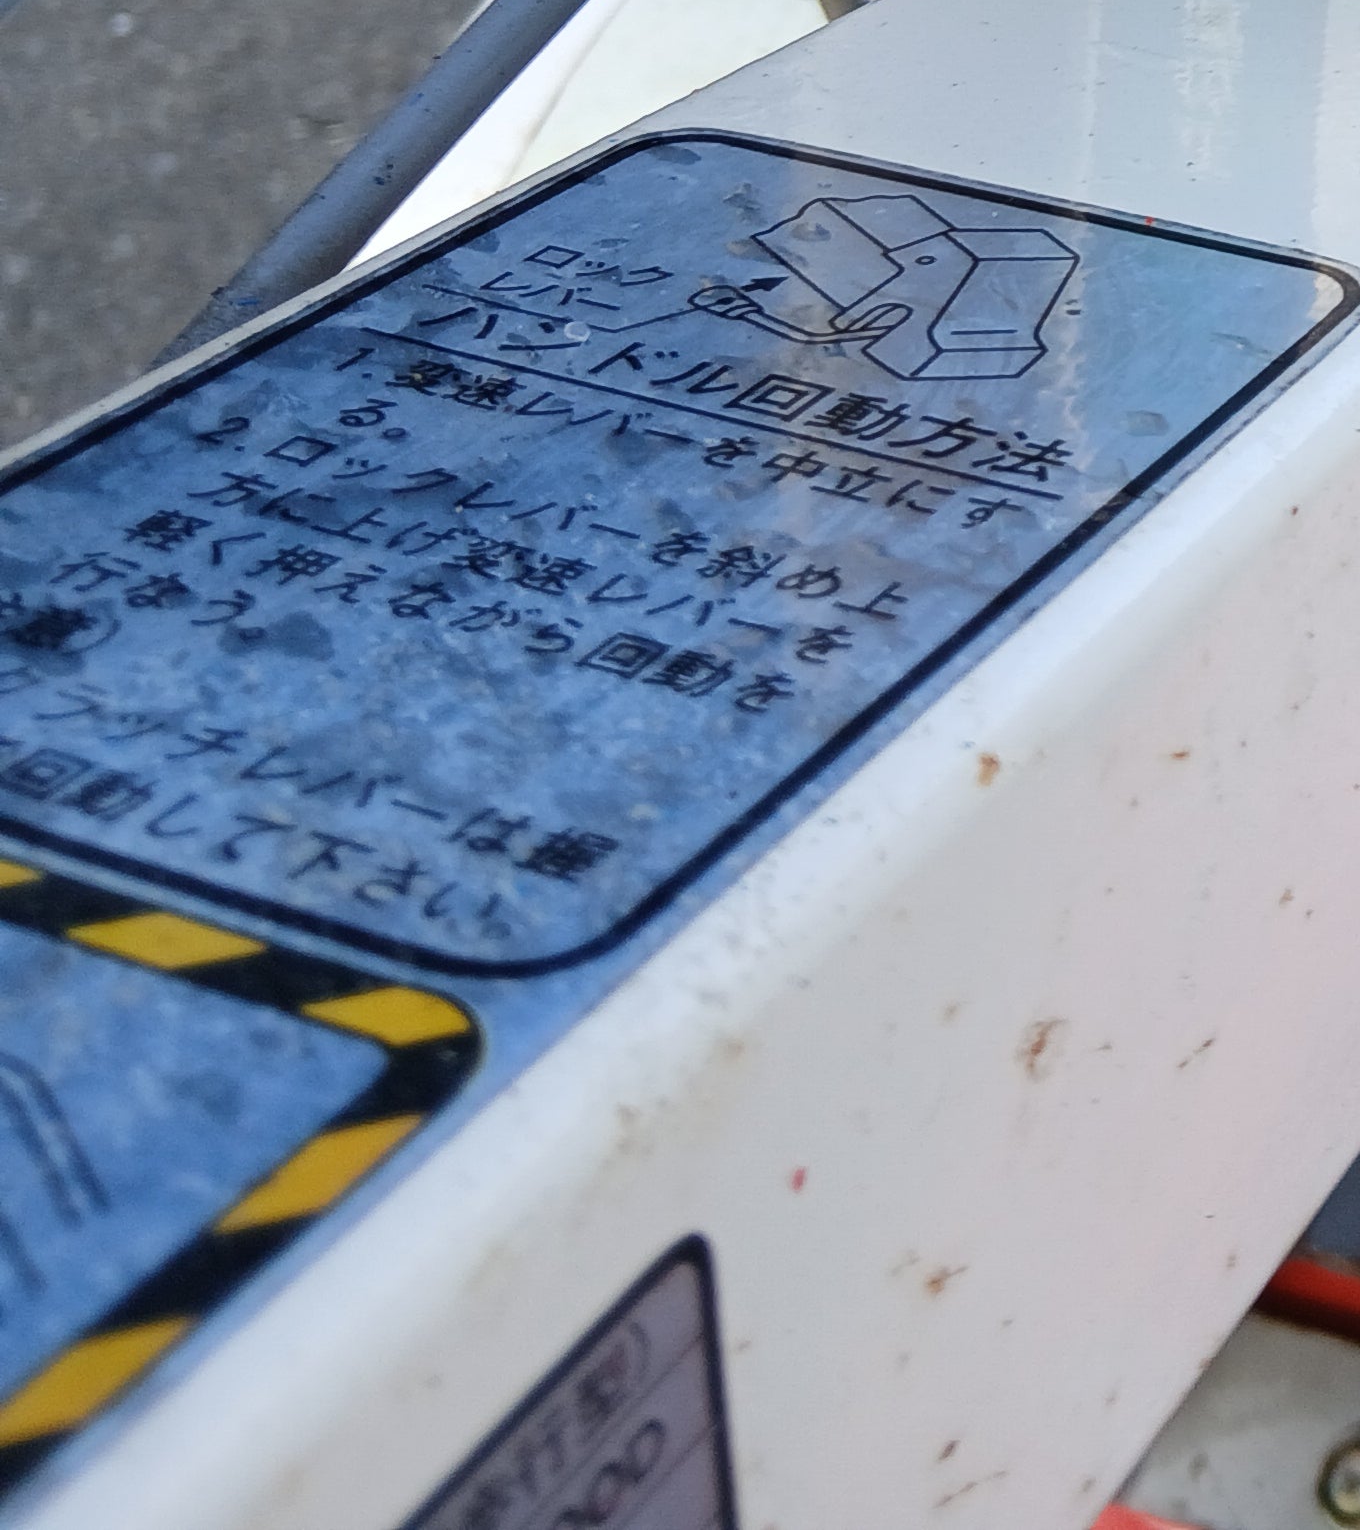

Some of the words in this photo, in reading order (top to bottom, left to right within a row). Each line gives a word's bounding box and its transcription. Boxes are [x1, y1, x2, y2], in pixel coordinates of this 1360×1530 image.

[523, 244, 674, 287] ロック
[480, 271, 622, 311] レバー
[417, 306, 1076, 483] ハンドル回動方法
[338, 397, 409, 442] る。
[186, 470, 853, 667] 方に上げ変速レバーを
